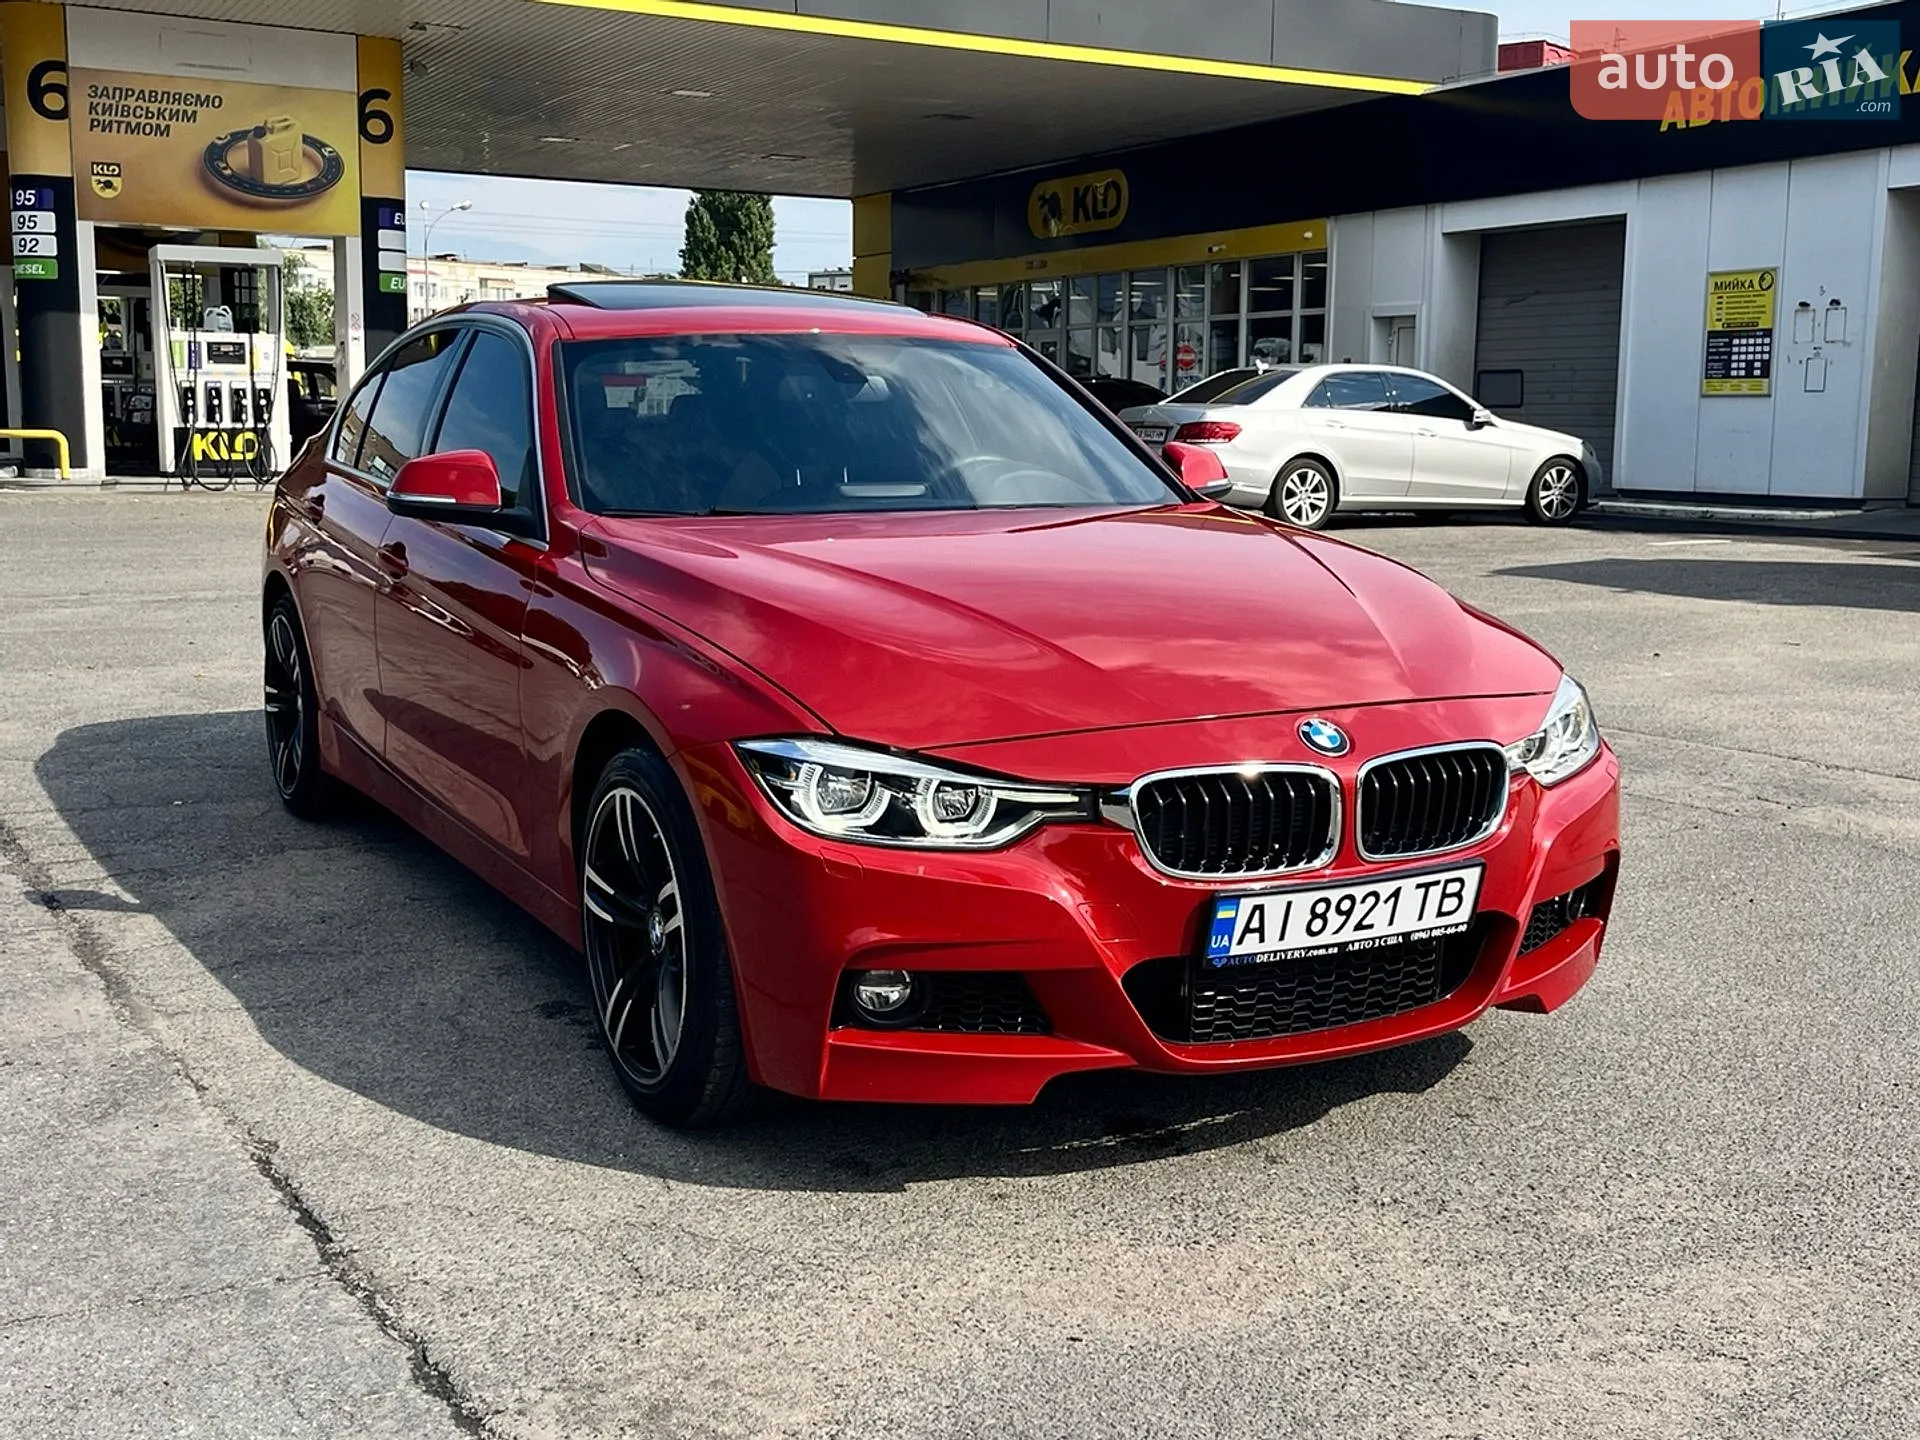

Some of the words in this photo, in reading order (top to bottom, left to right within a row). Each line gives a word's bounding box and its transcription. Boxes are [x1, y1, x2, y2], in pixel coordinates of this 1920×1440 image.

[27, 60, 68, 120] 6
[87, 84, 224, 109] ЗАПРАВЛЯЄМО
[1660, 42, 1920, 132] АВТОМИЙК
[88, 101, 198, 123] КИЇВСЬКИМ
[359, 89, 394, 144] 6
[89, 118, 171, 137] РИТМОМ
[93, 163, 120, 175] KLO
[15, 189, 36, 206] 95
[1073, 180, 1122, 224] KLO
[17, 214, 38, 230] 95
[18, 237, 39, 253] 92
[1713, 277, 1755, 292] МИЙКА
[193, 431, 259, 461] KLO
[1236, 901, 1292, 946] AI
[1305, 886, 1402, 938] 8921
[1414, 876, 1466, 922] TB
[1211, 934, 1229, 948] UA
